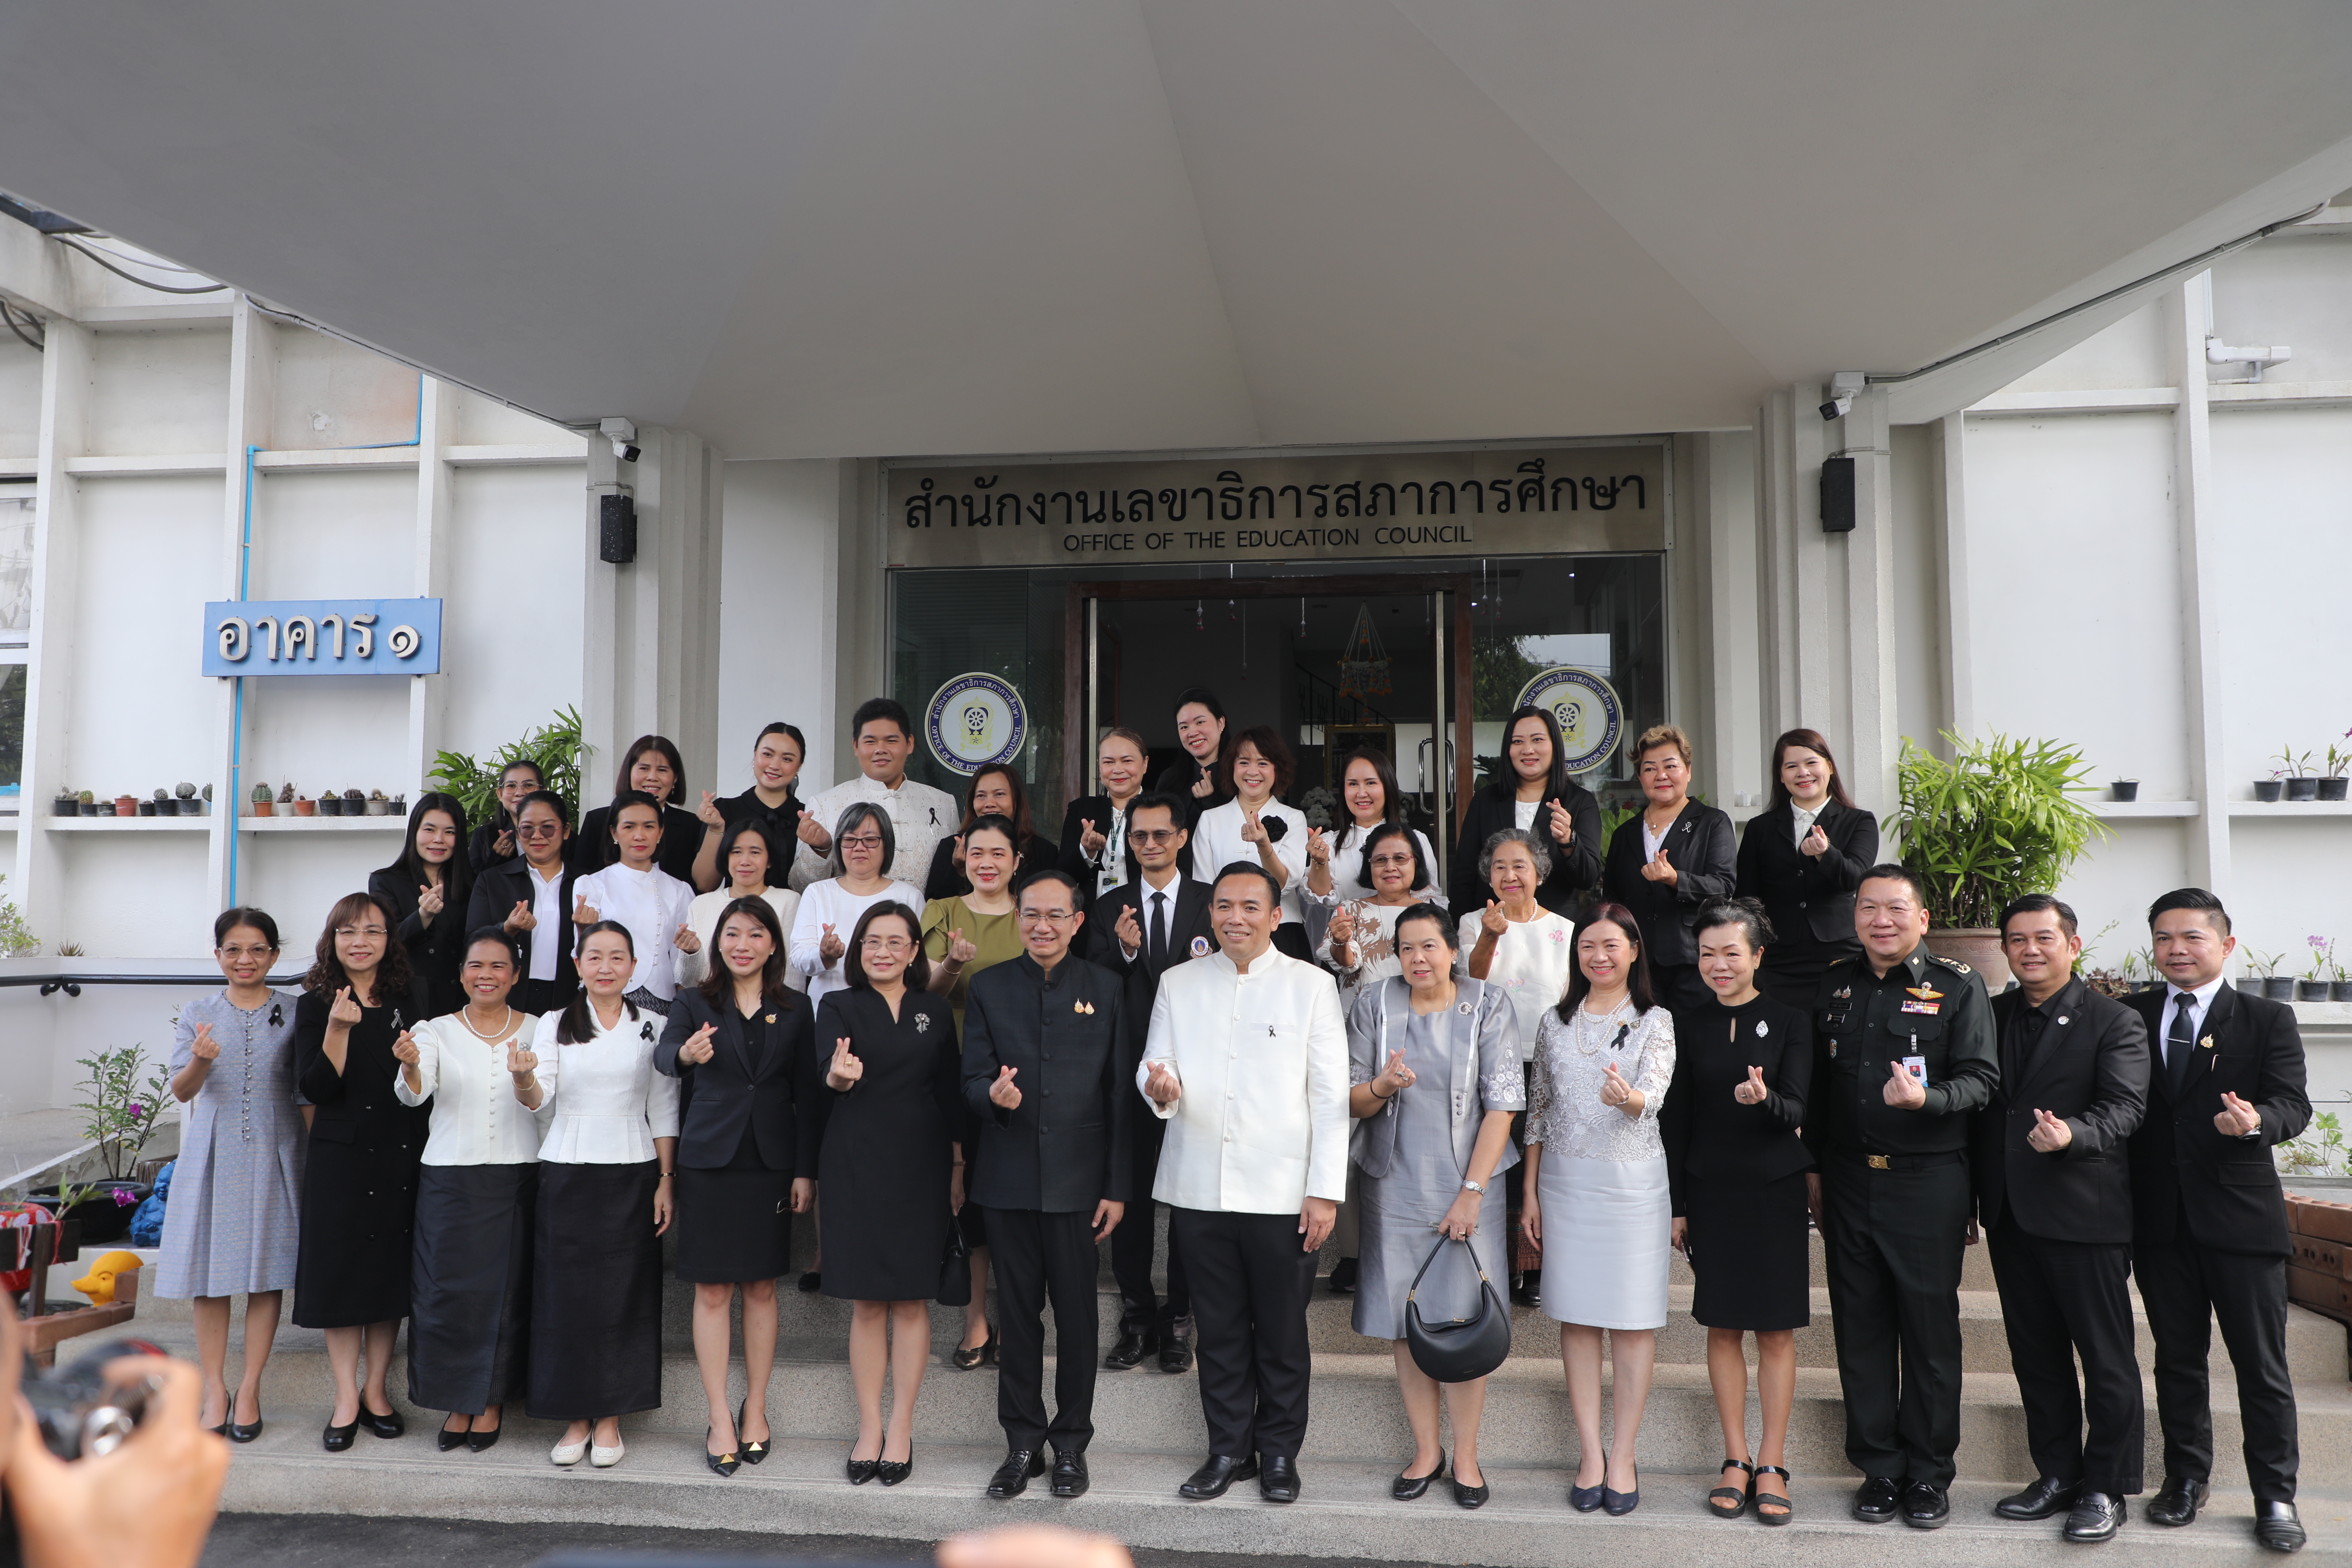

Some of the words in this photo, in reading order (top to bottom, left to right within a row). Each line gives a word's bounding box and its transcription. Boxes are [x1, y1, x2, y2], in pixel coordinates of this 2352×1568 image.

[905, 457, 1645, 528] สำนักงานเลขาธิการสภาการศึกษา
[1063, 533, 1134, 551] OFFICE
[1145, 532, 1174, 550] OF
[1183, 531, 1226, 549] THE
[1237, 528, 1359, 548] EDUCATION
[1374, 525, 1473, 544] COUNCIL
[217, 613, 379, 661] อาคาร
[388, 625, 421, 659] ๑
[932, 678, 1020, 719] สำนักงานเลขาธิการสภาการศึกษา
[1523, 673, 1614, 713] นักงานเลขาธิการสภาการศึกษา
[932, 726, 944, 751] OFFICE
[942, 751, 952, 760] OF
[950, 758, 964, 769] THE
[1004, 725, 1021, 757] COUNCIL
[1565, 752, 1601, 769] DUCATION
[1600, 720, 1616, 753] COUNCIL
